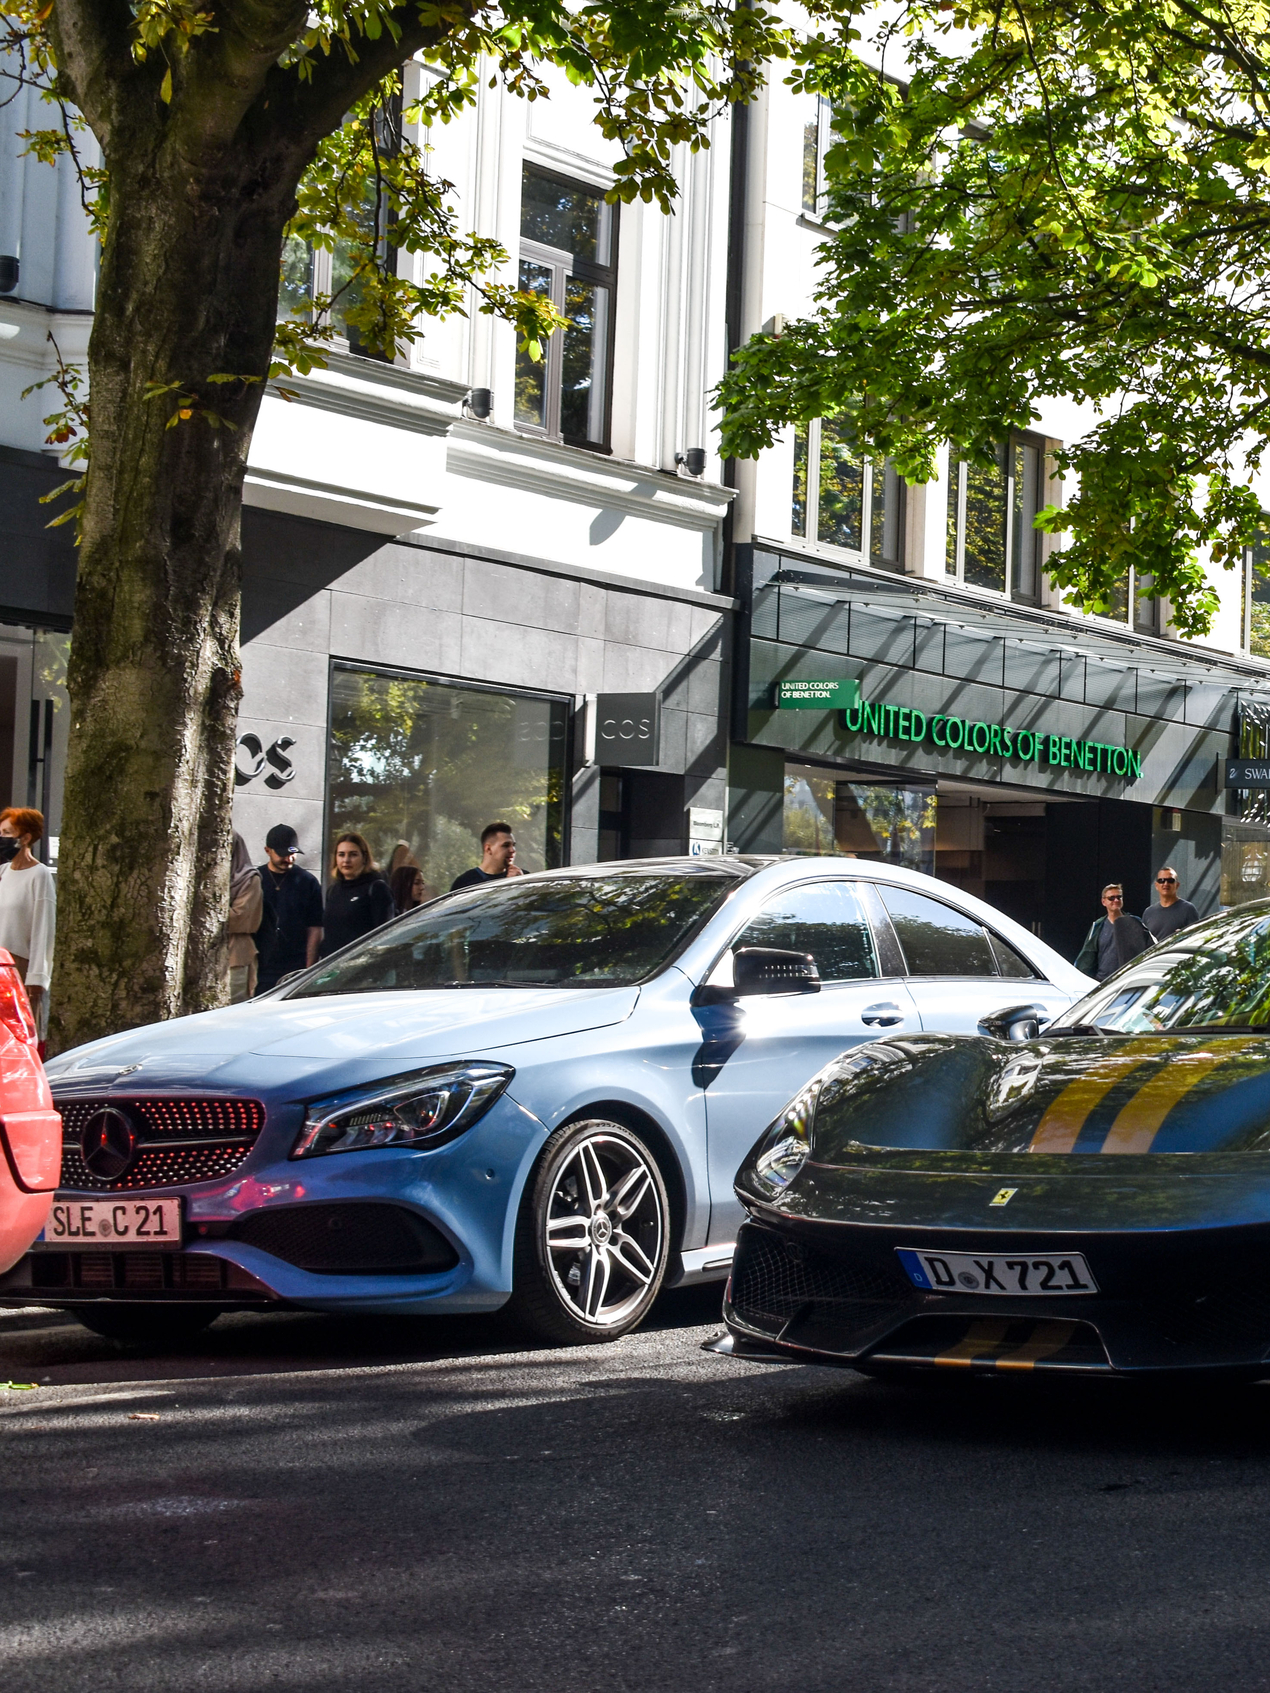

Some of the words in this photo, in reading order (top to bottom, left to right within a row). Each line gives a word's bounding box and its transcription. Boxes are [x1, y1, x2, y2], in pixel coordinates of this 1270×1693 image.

[781, 682, 808, 690] UNITED
[809, 682, 839, 690] COLORS
[781, 691, 792, 699] OF
[601, 719, 650, 739] COS
[846, 699, 926, 743] UNITED
[932, 714, 1013, 758] COLORS
[1017, 730, 1045, 762] OF
[234, 731, 297, 783] OS
[53, 1206, 96, 1237] SLE
[112, 1205, 129, 1236] C
[135, 1204, 168, 1236] 21
[924, 1256, 956, 1286] D
[973, 1260, 1007, 1290] X
[1005, 1259, 1089, 1291] 721
